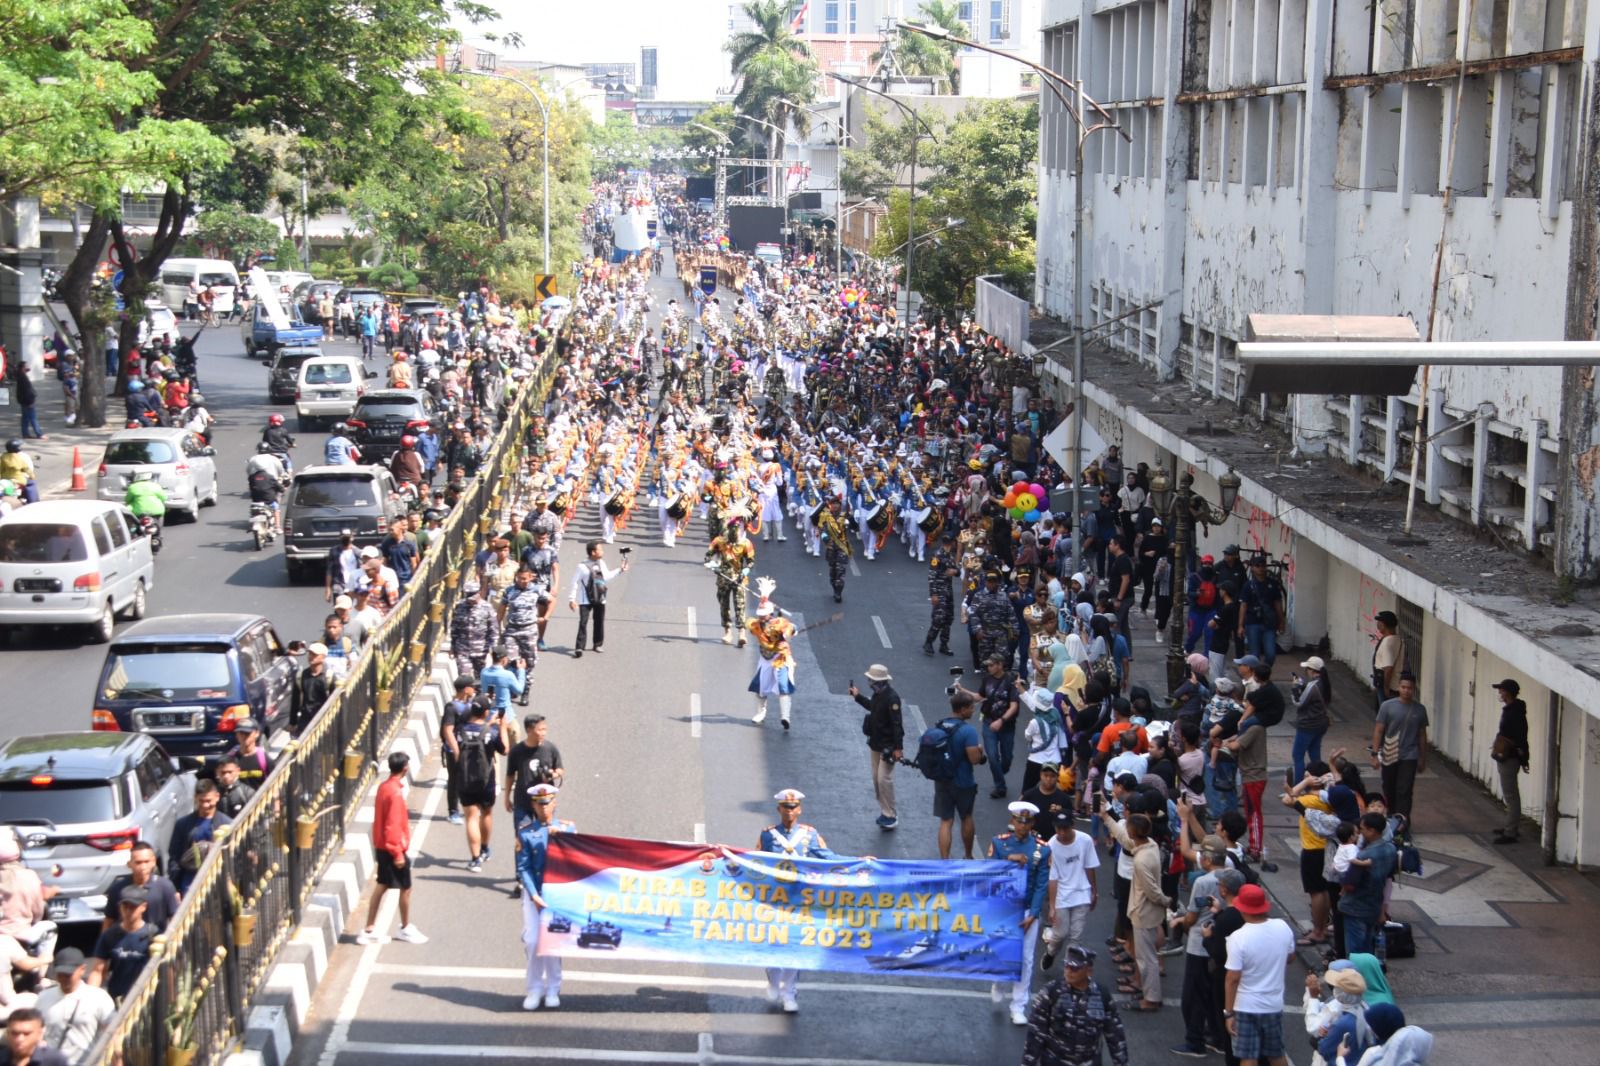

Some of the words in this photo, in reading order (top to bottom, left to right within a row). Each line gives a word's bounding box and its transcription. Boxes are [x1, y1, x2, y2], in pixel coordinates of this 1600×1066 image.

[620, 875, 706, 897] KIRAB
[717, 880, 789, 904] KOTA
[801, 888, 950, 911] SURABAYA
[584, 891, 682, 917] DALAM
[693, 900, 814, 924] RANGKA
[826, 907, 881, 929] HUT
[892, 911, 940, 931] TNI
[951, 914, 984, 933] AL
[690, 920, 789, 945] TAHUN
[800, 926, 872, 949] 2023
